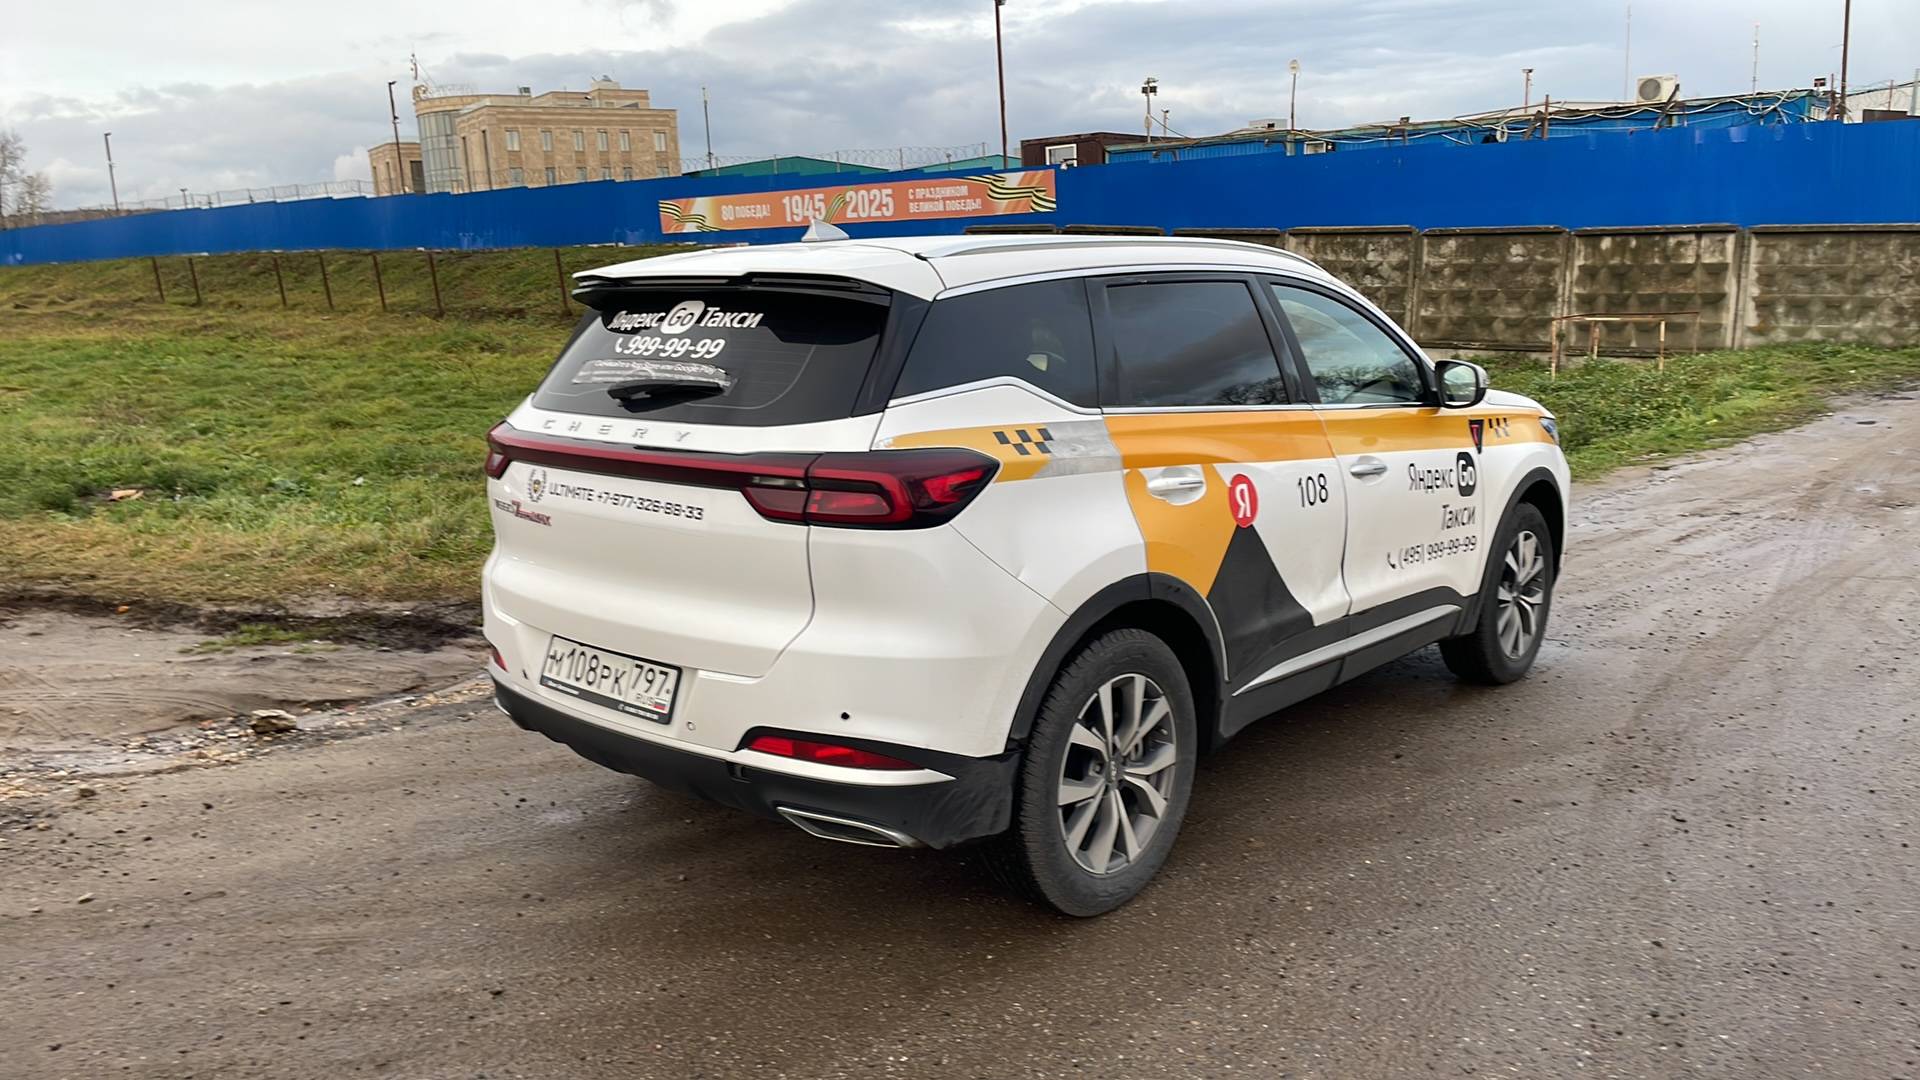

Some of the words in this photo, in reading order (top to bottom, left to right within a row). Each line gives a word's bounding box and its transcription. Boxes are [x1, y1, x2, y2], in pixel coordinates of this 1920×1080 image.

[721, 205, 734, 220] 80
[735, 204, 771, 219] ПОБЕДА!
[783, 193, 827, 222] 1945
[846, 189, 894, 218] 2025
[607, 309, 666, 330] Яндекс
[699, 307, 764, 329] Такси
[624, 336, 725, 358] 999-99-99
[542, 419, 691, 442] CHERY
[549, 482, 595, 501] ULTIMATE
[1298, 473, 1328, 508] 108
[1408, 463, 1454, 494] Яндекс
[1235, 483, 1251, 518] Я
[1441, 504, 1476, 530] Такси
[1399, 543, 1425, 569] (495)
[1427, 535, 1477, 561] 999-99-99
